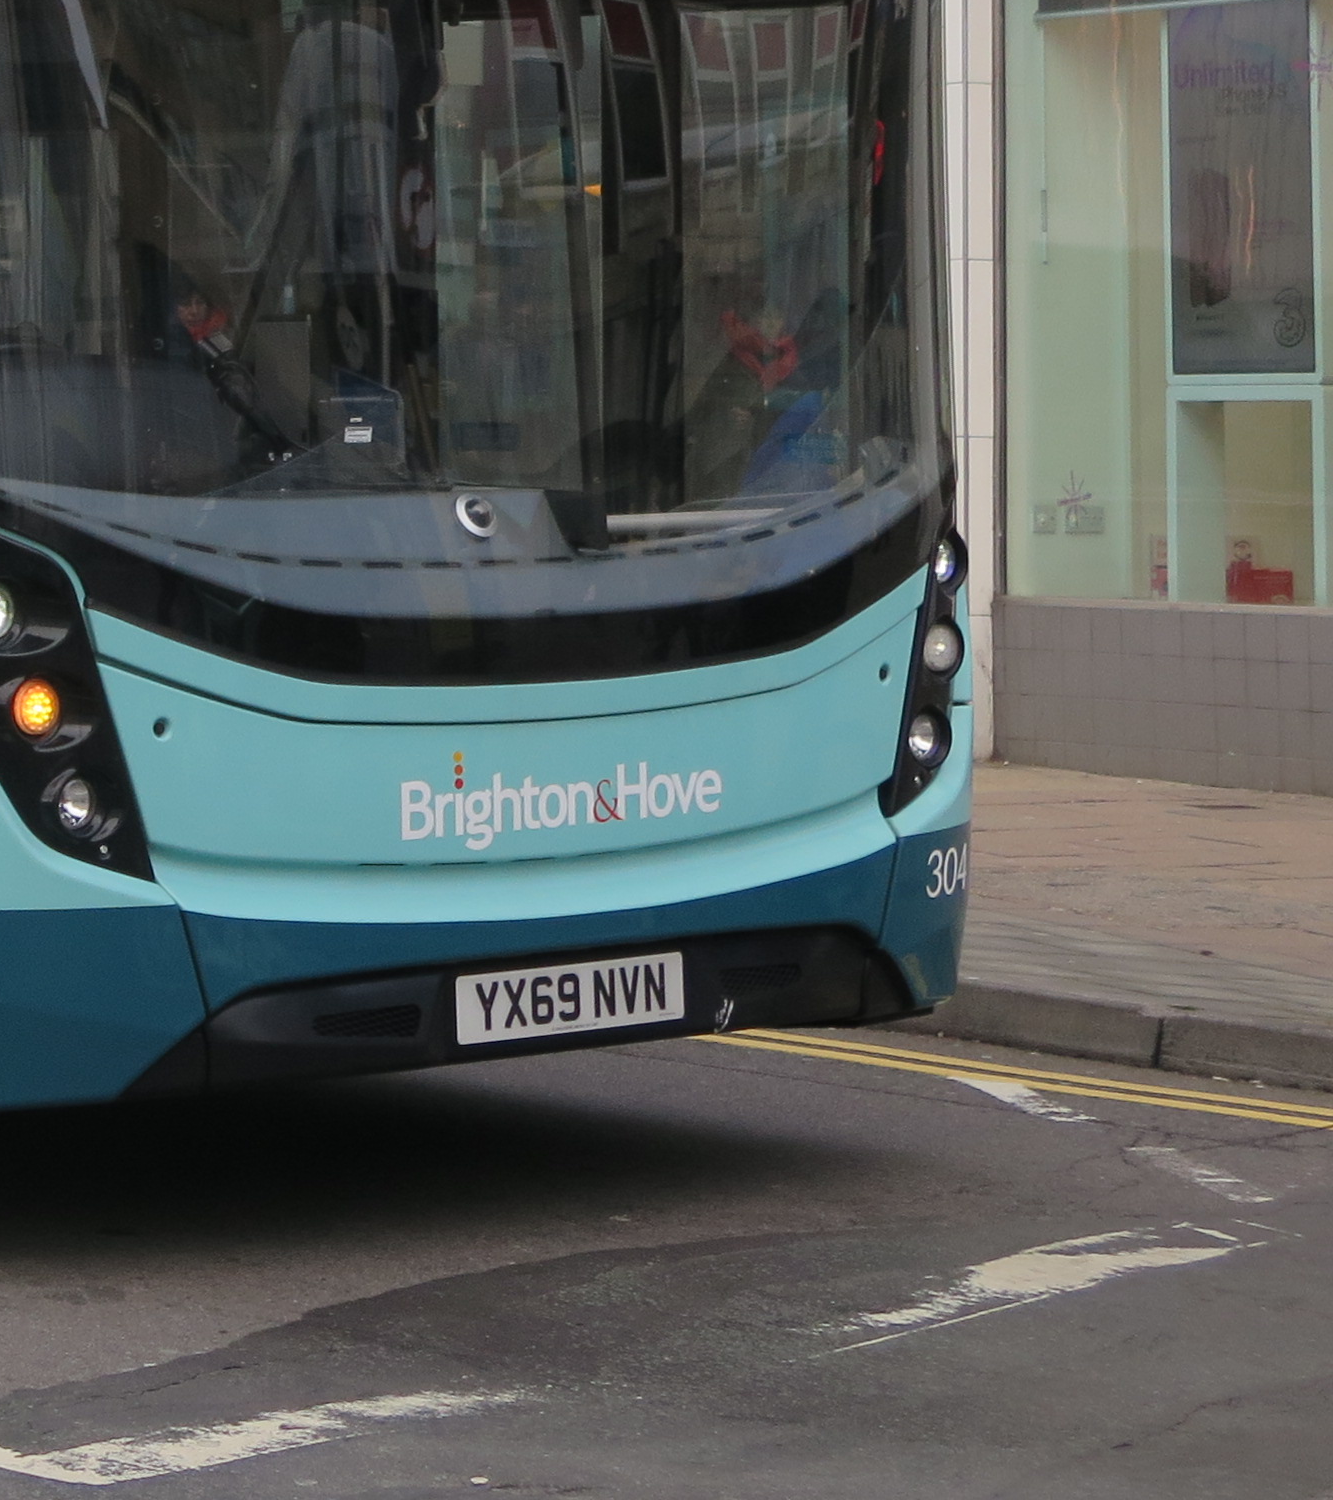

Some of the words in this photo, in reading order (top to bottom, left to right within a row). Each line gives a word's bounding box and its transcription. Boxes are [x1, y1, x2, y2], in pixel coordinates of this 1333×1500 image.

[925, 843, 967, 898] 304
[475, 972, 581, 1032] YX69
[593, 961, 667, 1019] NVN
